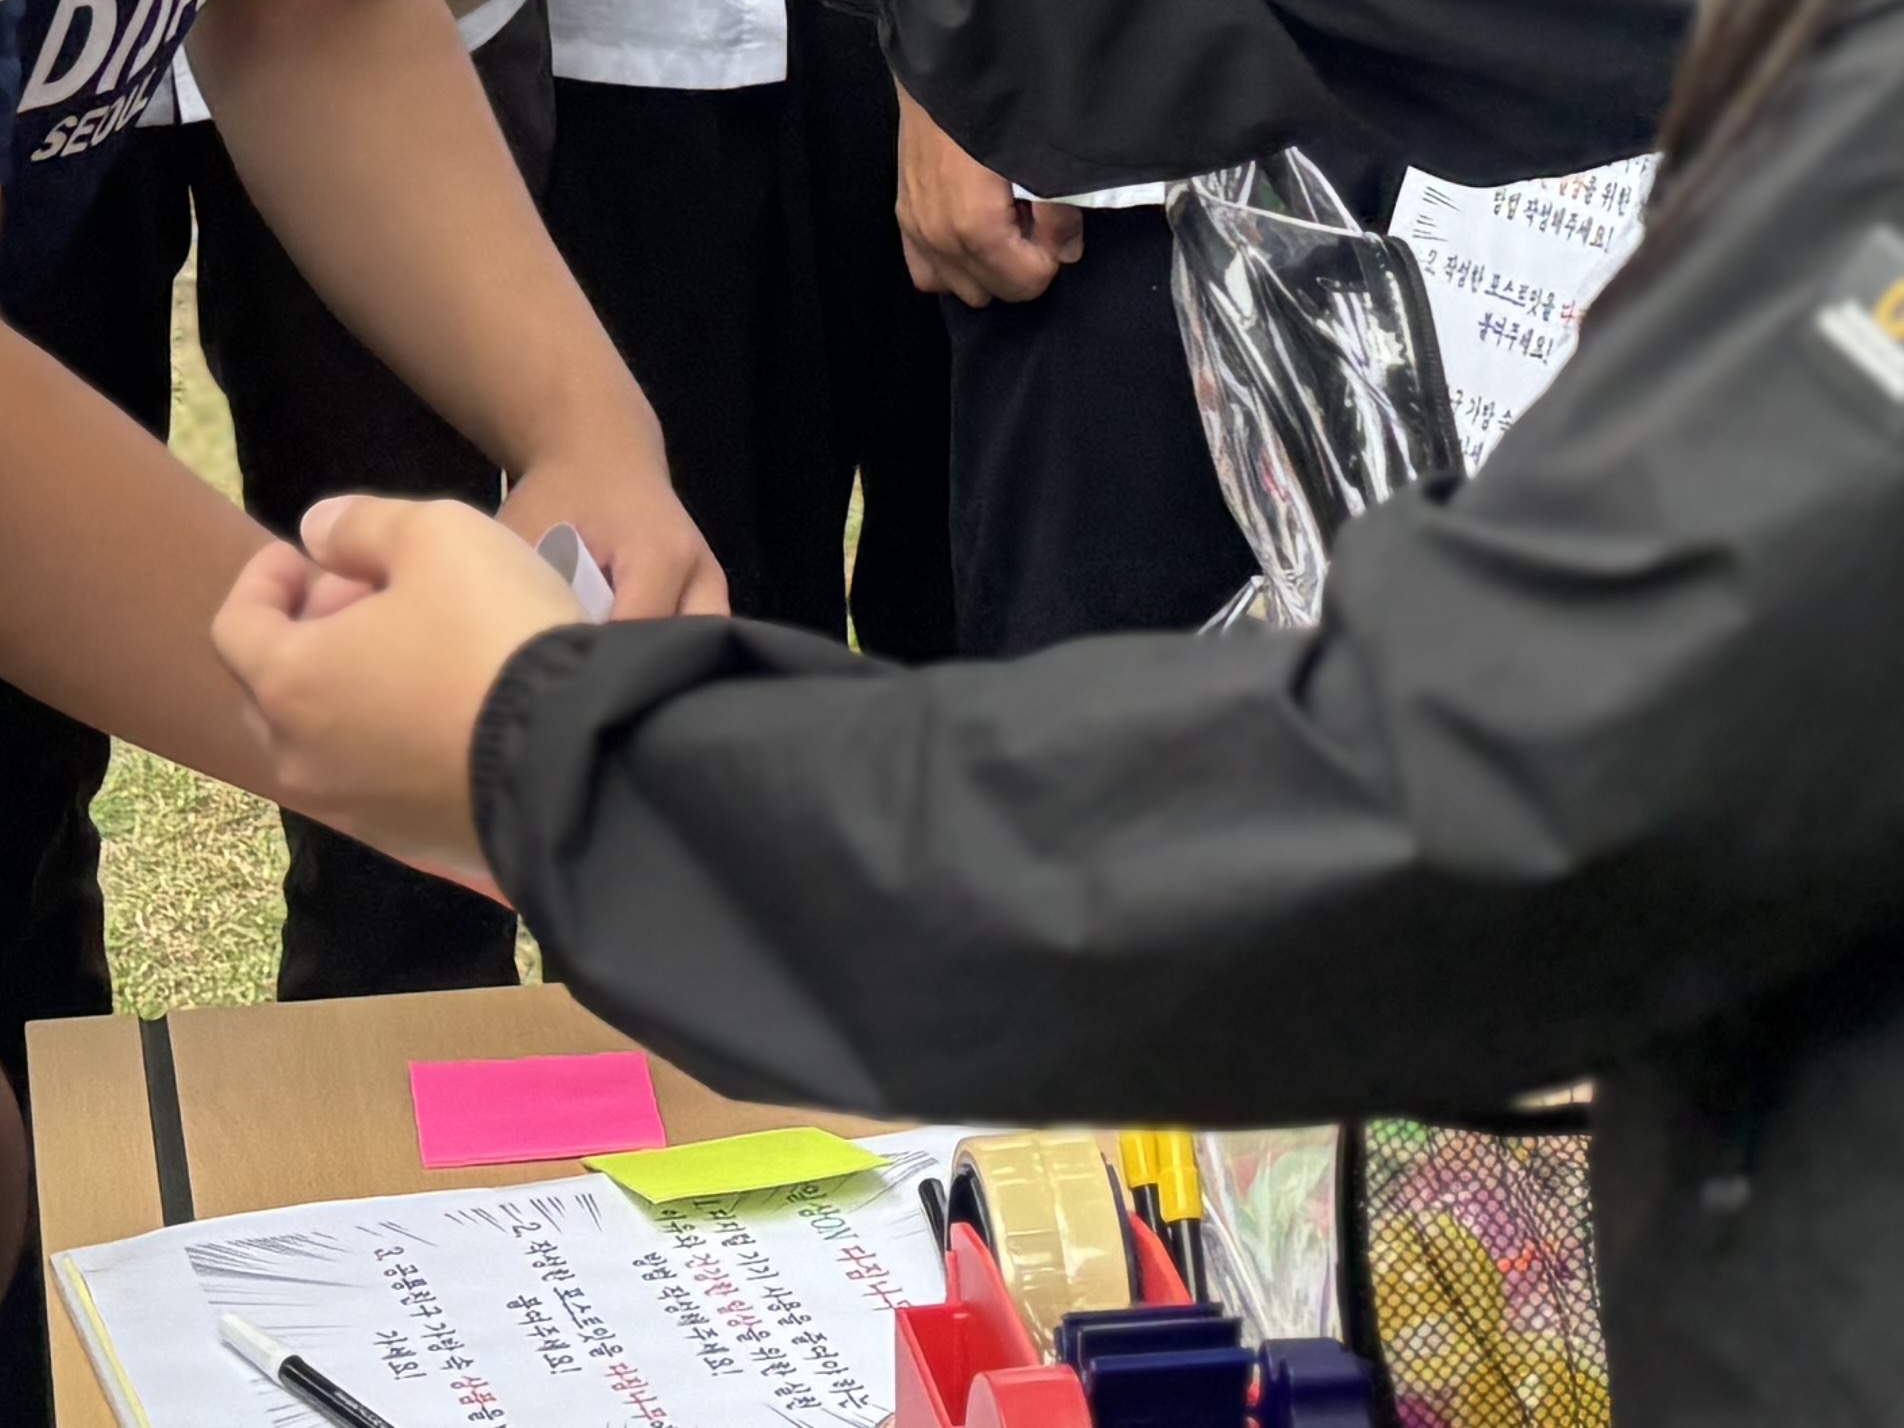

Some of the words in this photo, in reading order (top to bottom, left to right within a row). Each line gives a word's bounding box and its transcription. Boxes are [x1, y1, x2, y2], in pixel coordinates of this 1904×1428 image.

[1523, 198, 1614, 253] 작성해주세요!
[1601, 182, 1632, 217] 위한
[1443, 255, 1486, 294] 작성한
[1483, 274, 1556, 321] 포스트잇을
[1478, 312, 1554, 364] 붙여주세요!
[1465, 396, 1495, 431] 가방
[382, 1263, 444, 1318] 공통친구
[524, 1239, 577, 1283] 작성한
[552, 1286, 625, 1359] 포스트잇을
[632, 1251, 678, 1282] 방법
[656, 1285, 744, 1377] 작성해주세요!
[654, 1208, 707, 1249] 이유와
[684, 1252, 741, 1297] 건강한
[716, 1299, 771, 1343] 일상을
[749, 1347, 797, 1377] 위한
[774, 1381, 822, 1410] 실천
[707, 1208, 757, 1248] 디지털
[737, 1250, 780, 1282] 기기
[760, 1285, 812, 1327] 사용을
[791, 1331, 849, 1375] 줄여야
[829, 1378, 870, 1410] 하는
[371, 1329, 428, 1381] 가세요!
[420, 1322, 466, 1352] 가방
[505, 1294, 584, 1376] 붙여주세요!
[440, 1355, 475, 1371] 속
[449, 1374, 505, 1422] 상품을
